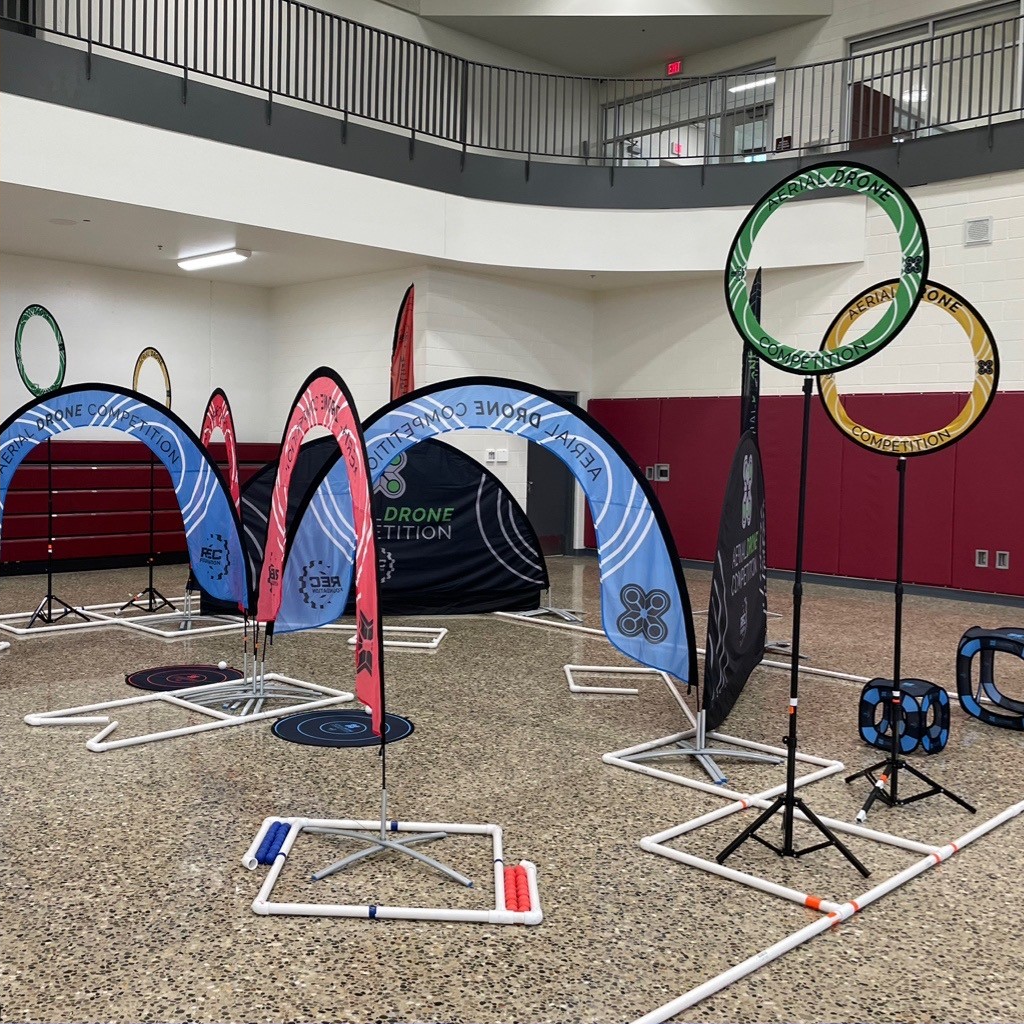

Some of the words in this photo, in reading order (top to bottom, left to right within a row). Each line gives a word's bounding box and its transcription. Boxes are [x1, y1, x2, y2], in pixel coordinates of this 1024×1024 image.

[667, 61, 681, 75] EXIT
[766, 171, 827, 211] AERIAL
[832, 169, 895, 202] DRONE
[921, 288, 962, 313] ONE
[759, 336, 868, 369] COMPETITION
[0, 426, 36, 475] AERIAL
[36, 403, 83, 430] DRONE
[87, 403, 180, 465] COMPETITION
[851, 424, 951, 453] COMPETITION
[383, 506, 454, 522] DRONE
[377, 525, 451, 540] TITION
